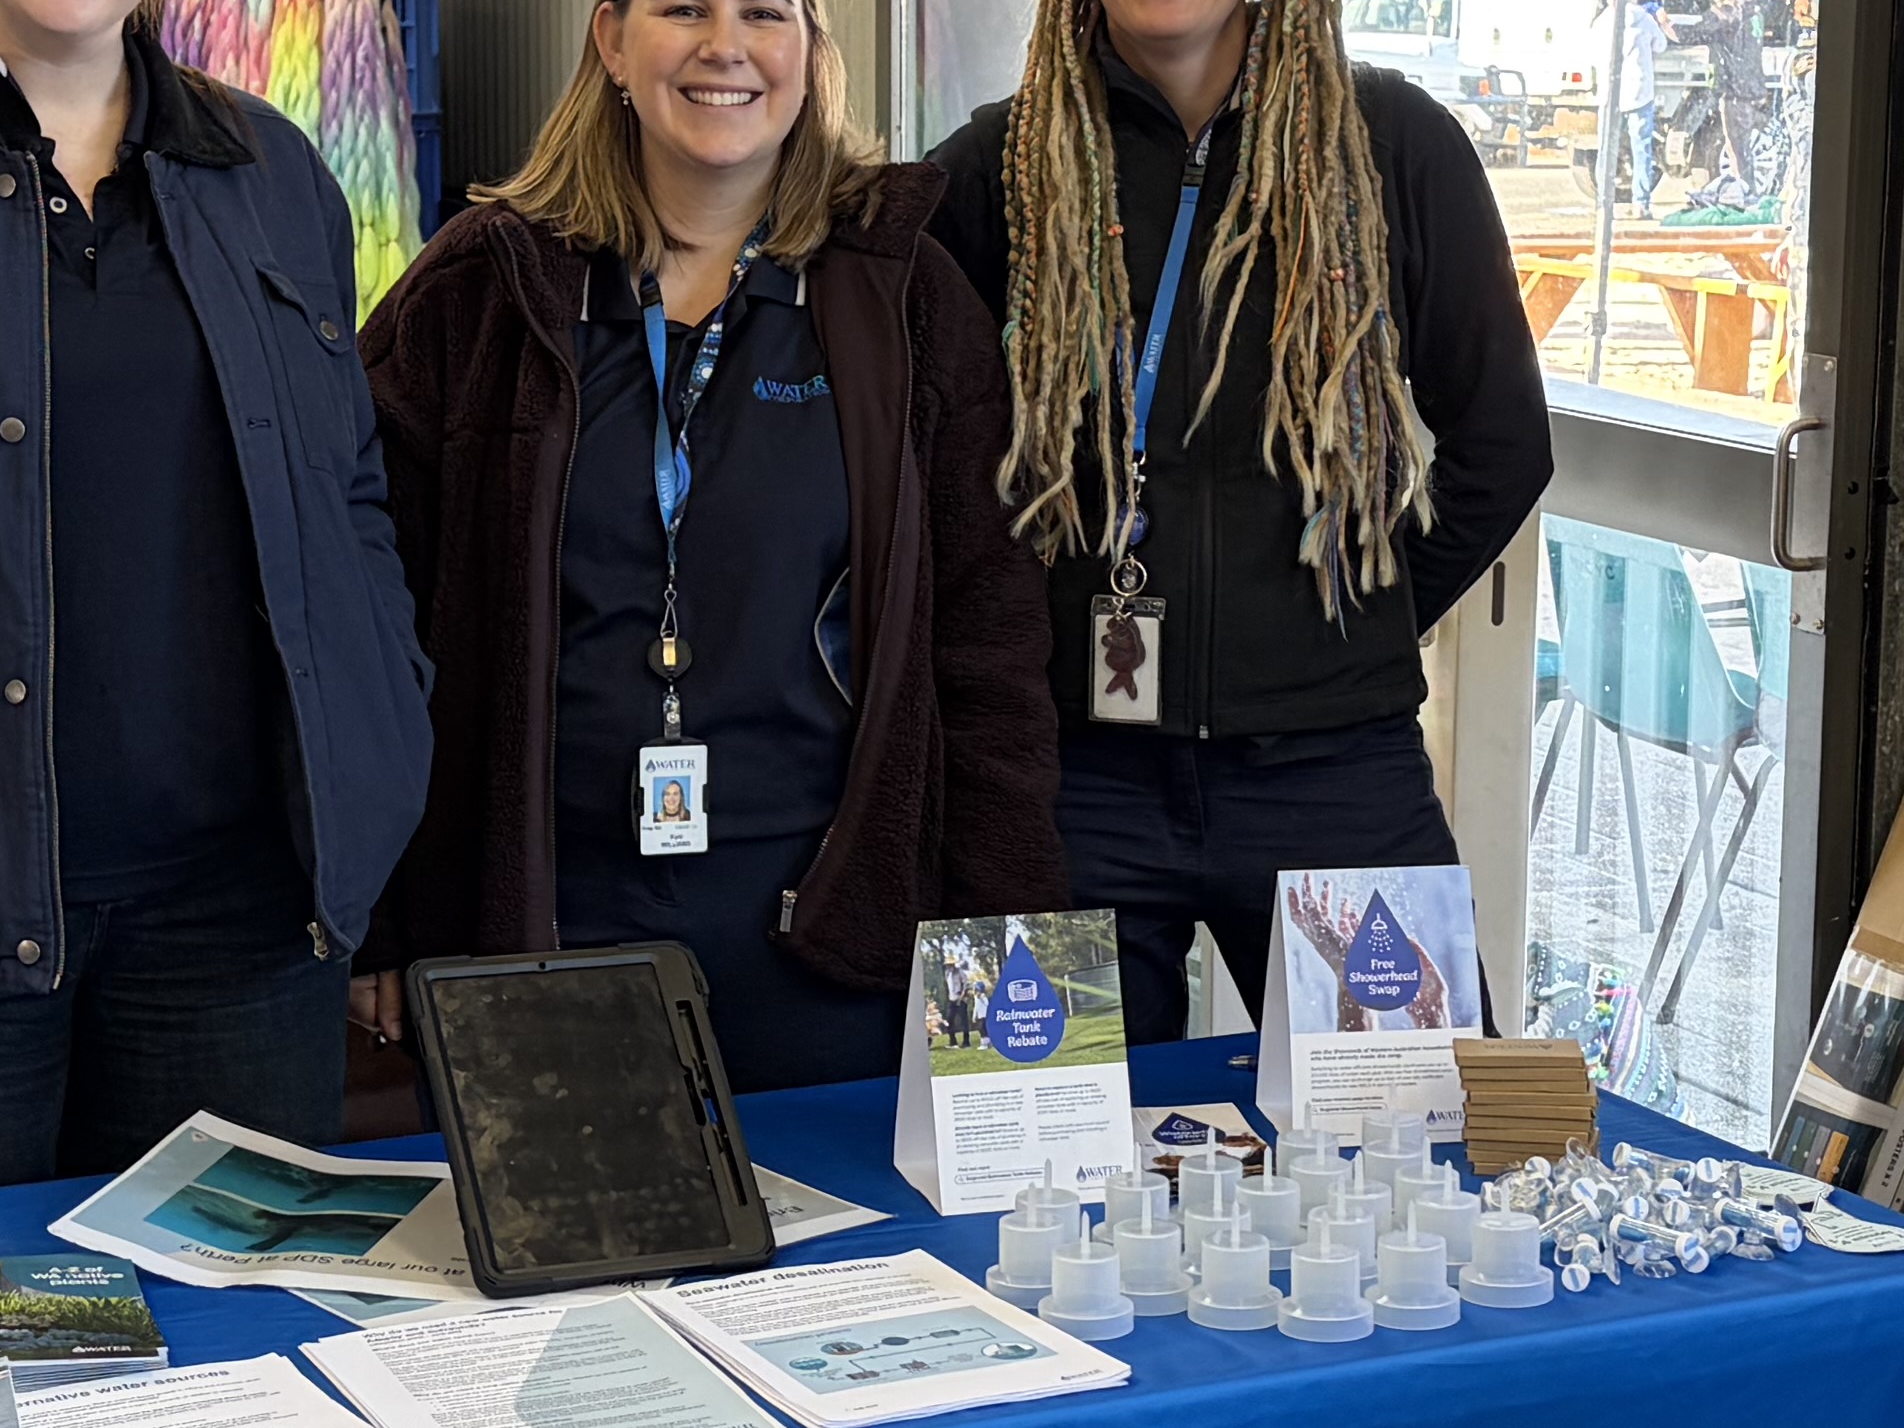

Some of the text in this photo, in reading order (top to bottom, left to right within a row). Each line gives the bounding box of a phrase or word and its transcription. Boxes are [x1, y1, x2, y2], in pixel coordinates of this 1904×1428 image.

[767, 375, 828, 401] WATER
[1370, 958, 1396, 970] Free
[1348, 969, 1418, 984] Showerhead
[1367, 984, 1401, 997] Swap
[996, 1008, 1056, 1022] Rainwater
[1012, 1021, 1041, 1034] Tank
[1007, 1034, 1048, 1048] Rebate
[676, 1260, 891, 1298] Seawater desalination
[95, 1378, 151, 1395] water
[154, 1369, 231, 1385] sources
